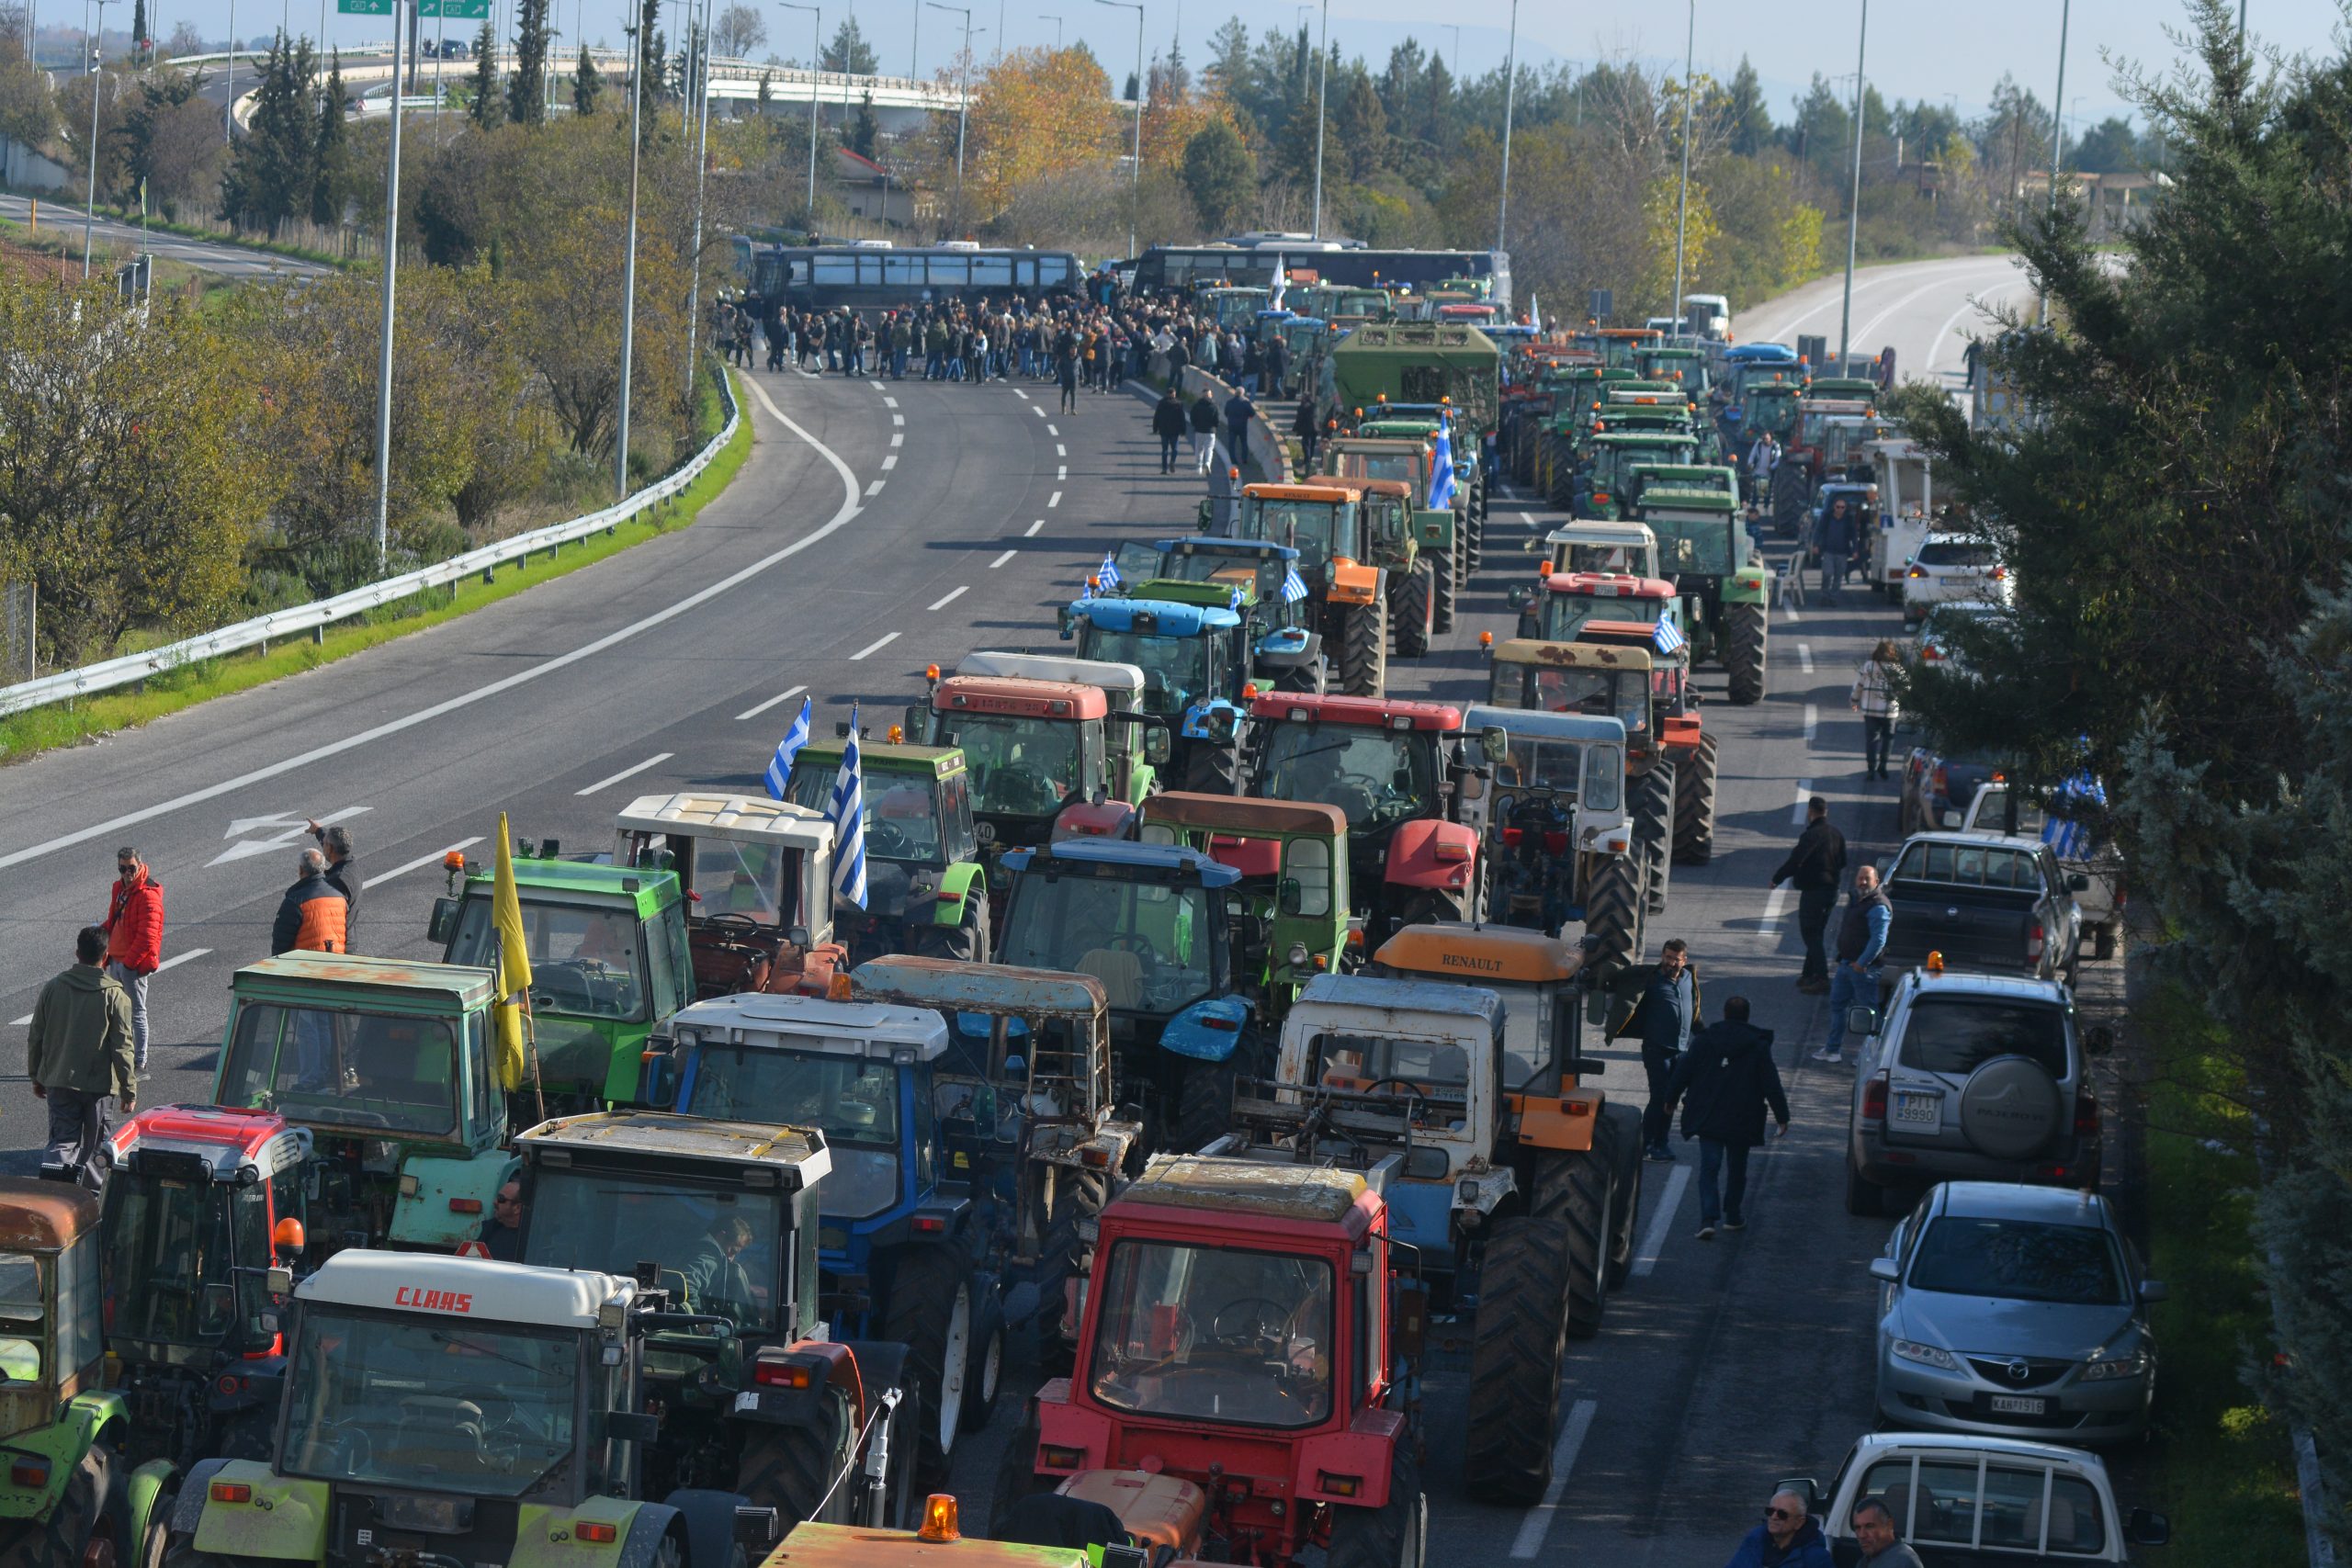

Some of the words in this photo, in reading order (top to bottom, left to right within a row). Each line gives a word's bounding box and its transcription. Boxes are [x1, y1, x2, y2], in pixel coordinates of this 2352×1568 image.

[978, 824, 991, 839] 40
[1442, 954, 1503, 972] RENAULT
[1904, 1109, 1934, 1122] 9990
[395, 1286, 473, 1314] CLAAS
